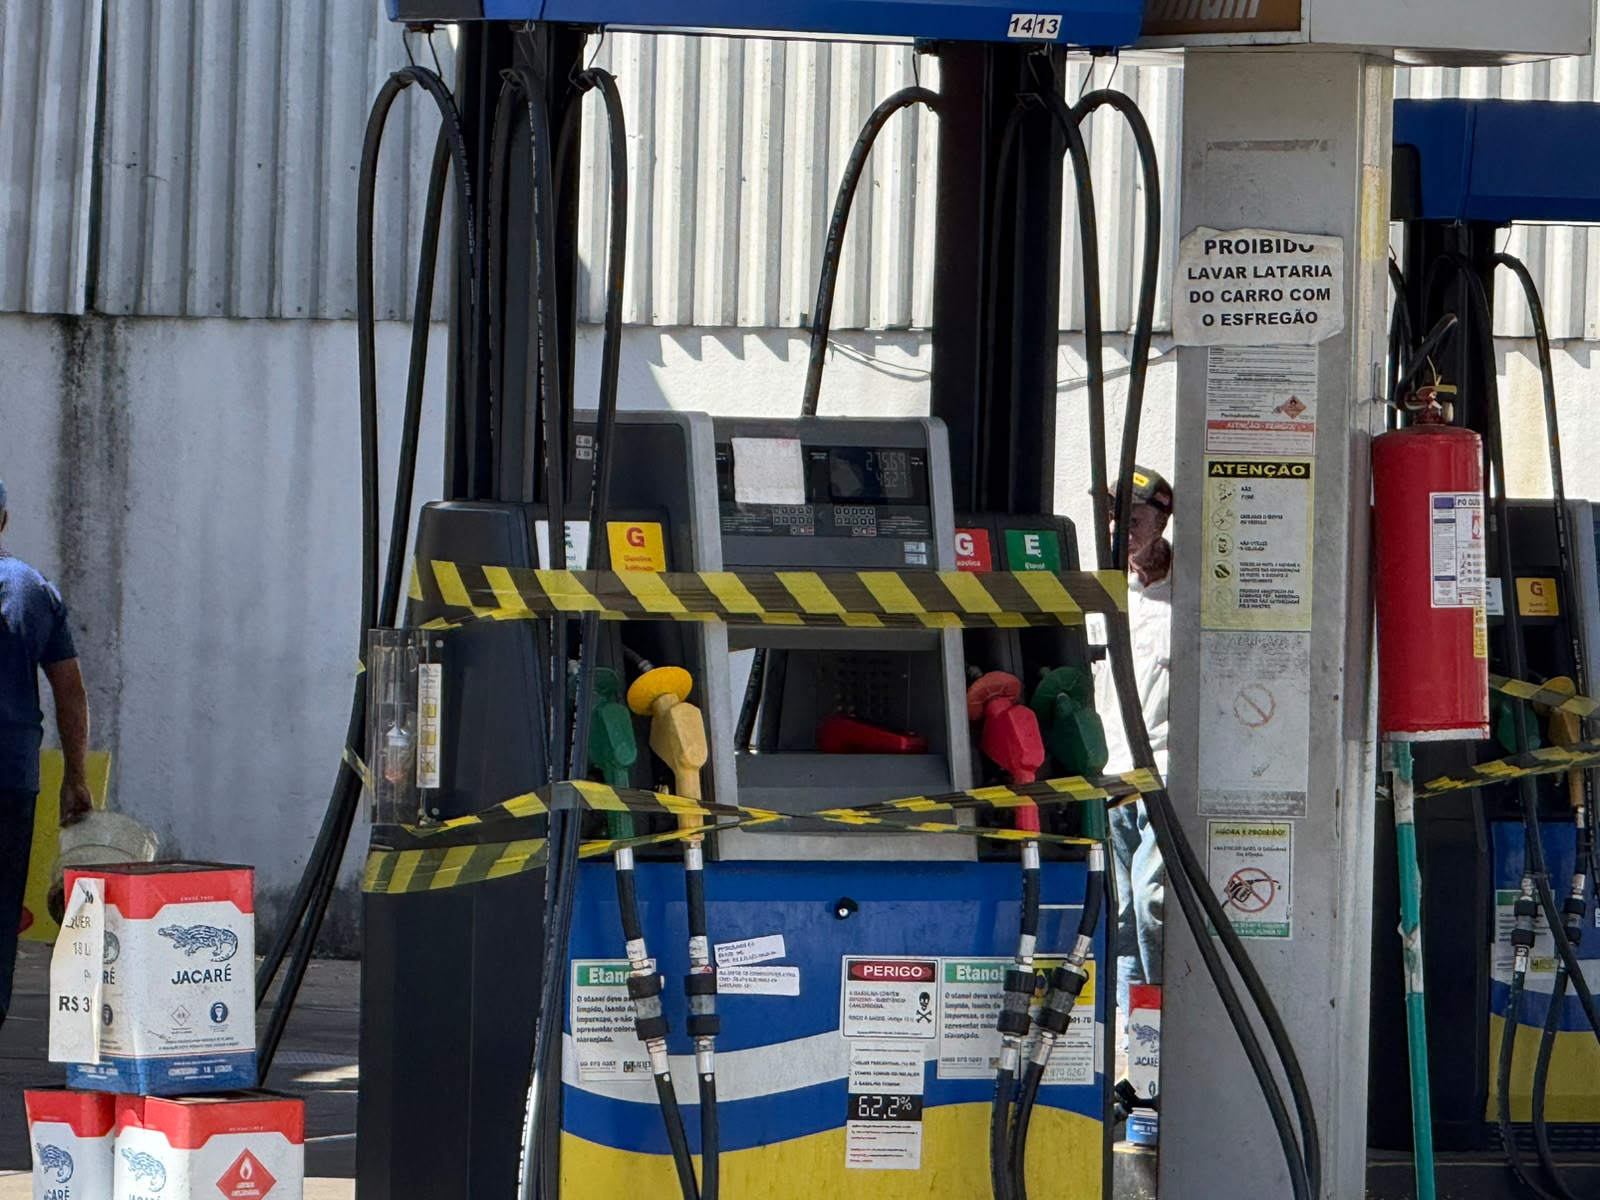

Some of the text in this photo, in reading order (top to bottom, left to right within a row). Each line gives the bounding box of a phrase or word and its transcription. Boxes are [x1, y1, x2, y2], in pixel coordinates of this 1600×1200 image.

[1010, 18, 1058, 34] 14 13
[1187, 265, 1332, 280] LAVAR LATARIA
[1189, 287, 1330, 303] DO CARRO COM
[1202, 308, 1318, 326] O ESFREGÃO
[1211, 463, 1305, 477] ATENÇÃO
[627, 527, 645, 549] G
[955, 532, 974, 556] G
[1024, 534, 1041, 557] E
[1530, 581, 1544, 597] G
[171, 963, 232, 985] JACARÉ
[863, 965, 922, 977] PERIGO
[59, 995, 79, 1013] R$
[858, 1096, 912, 1119] 62,2%
